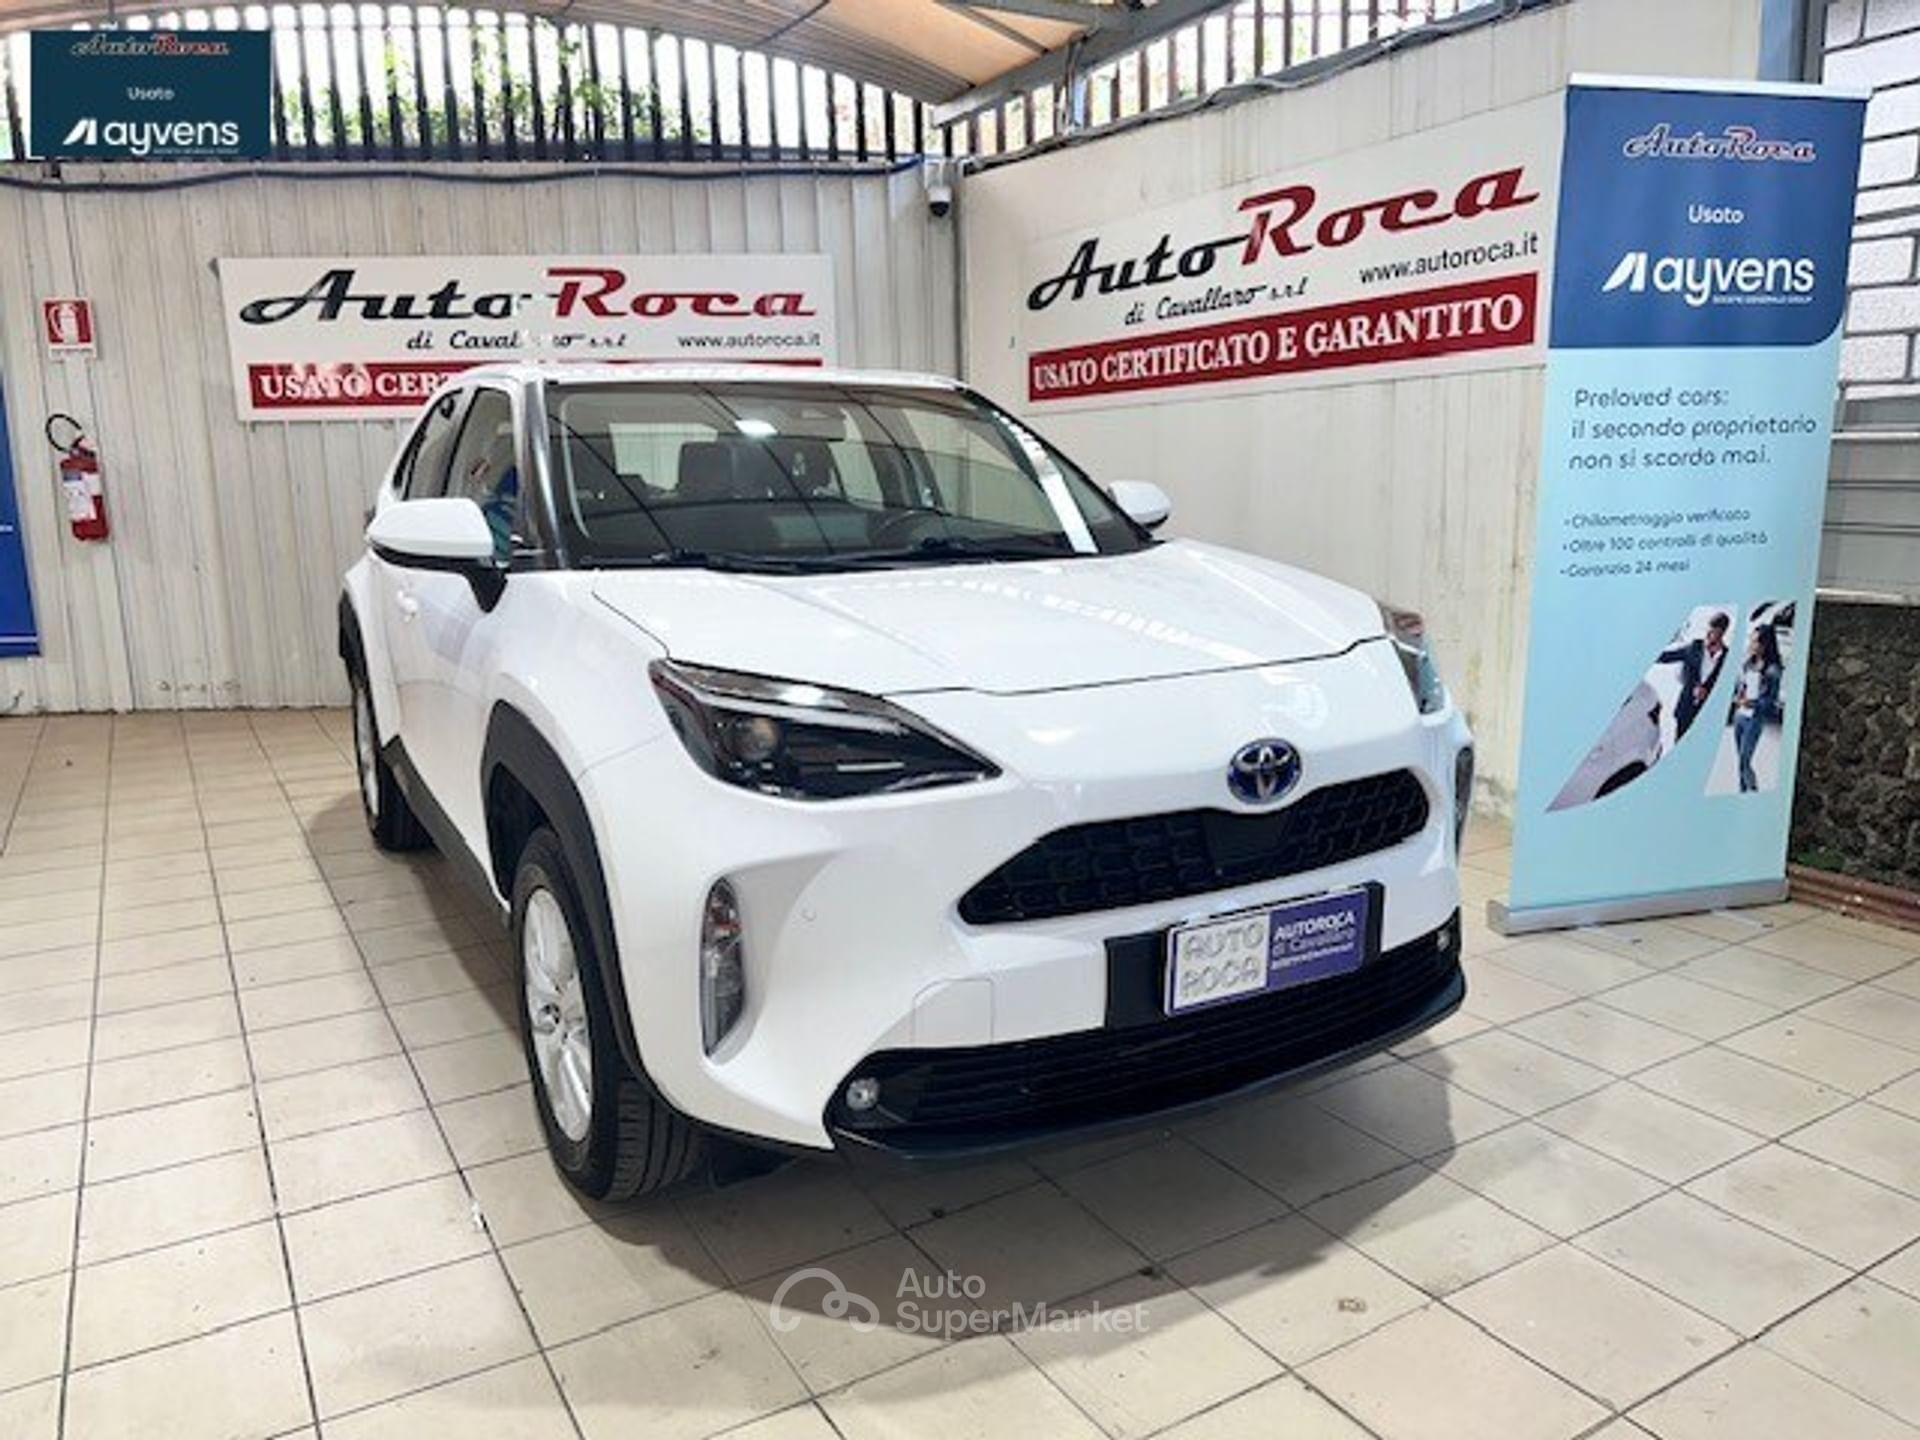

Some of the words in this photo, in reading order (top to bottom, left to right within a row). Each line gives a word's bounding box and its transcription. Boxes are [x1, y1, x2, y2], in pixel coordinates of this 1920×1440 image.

[1688, 205, 1744, 223] Usato
[1358, 232, 1538, 284] www.autoroca.it
[1653, 255, 1814, 306] ayvens
[1125, 302, 1145, 326] di
[1155, 285, 1267, 321] Cavallaro
[407, 329, 434, 350] di
[677, 332, 821, 348] www.autoroca.it
[1033, 359, 1098, 391] USATO
[1101, 331, 1270, 382] CERTIFICATO
[1277, 325, 1298, 361] E
[1305, 293, 1523, 358] GARANTITO
[260, 371, 371, 398] USATO
[1575, 387, 1672, 409] Preloved
[1677, 389, 1730, 407] cars:
[1571, 420, 1585, 439] il
[1592, 417, 1686, 438] secondo
[1692, 413, 1817, 440] proprietario
[1569, 453, 1613, 469] non
[1620, 447, 1636, 468] si
[1643, 446, 1716, 467] scorda
[1722, 444, 1772, 465] mai.
[1686, 507, 1751, 523] verificato
[1569, 538, 1606, 553] Oltre
[1610, 536, 1634, 550] 100
[1638, 533, 1696, 550] controlli
[1701, 533, 1713, 546] di
[1567, 562, 1632, 577] Garanzia
[1635, 560, 1652, 574] 24
[1656, 558, 1691, 573] mesi
[1273, 910, 1355, 943] AUTOROCA
[1182, 922, 1264, 960] AUTO
[1182, 957, 1260, 998] ROCA
